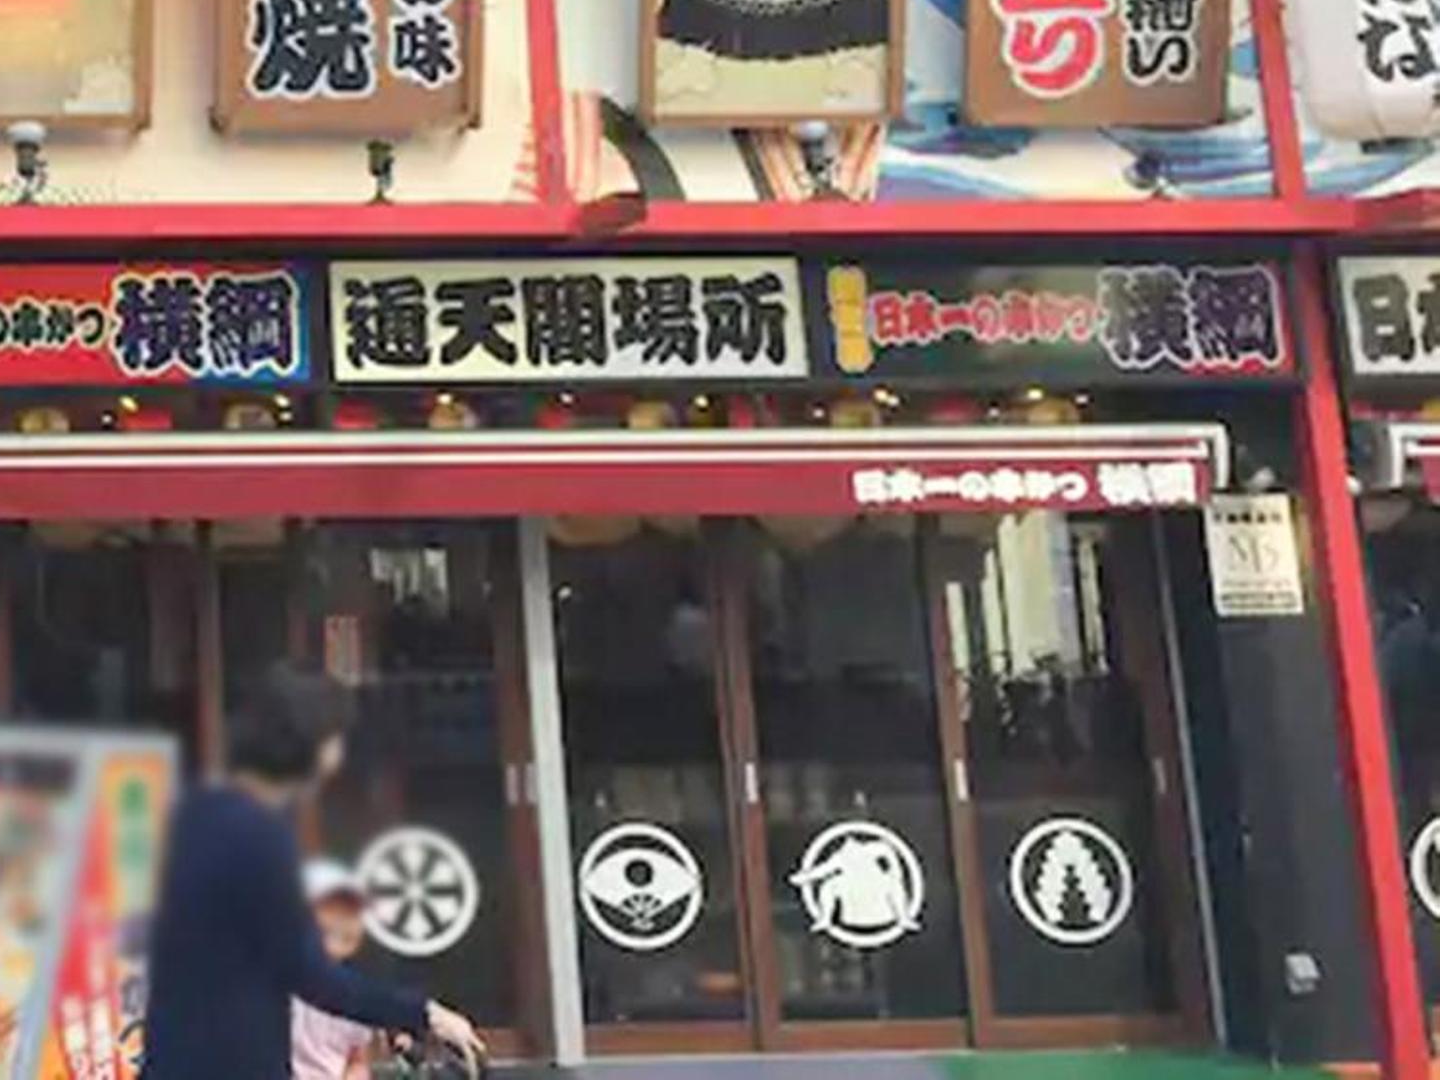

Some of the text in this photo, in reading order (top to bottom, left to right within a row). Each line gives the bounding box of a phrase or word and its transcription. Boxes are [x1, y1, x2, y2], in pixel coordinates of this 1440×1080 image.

[116, 277, 294, 370] 横綱
[343, 273, 788, 367] 通天閣場所
[873, 269, 1279, 362] 日本一の串かつ 横綱
